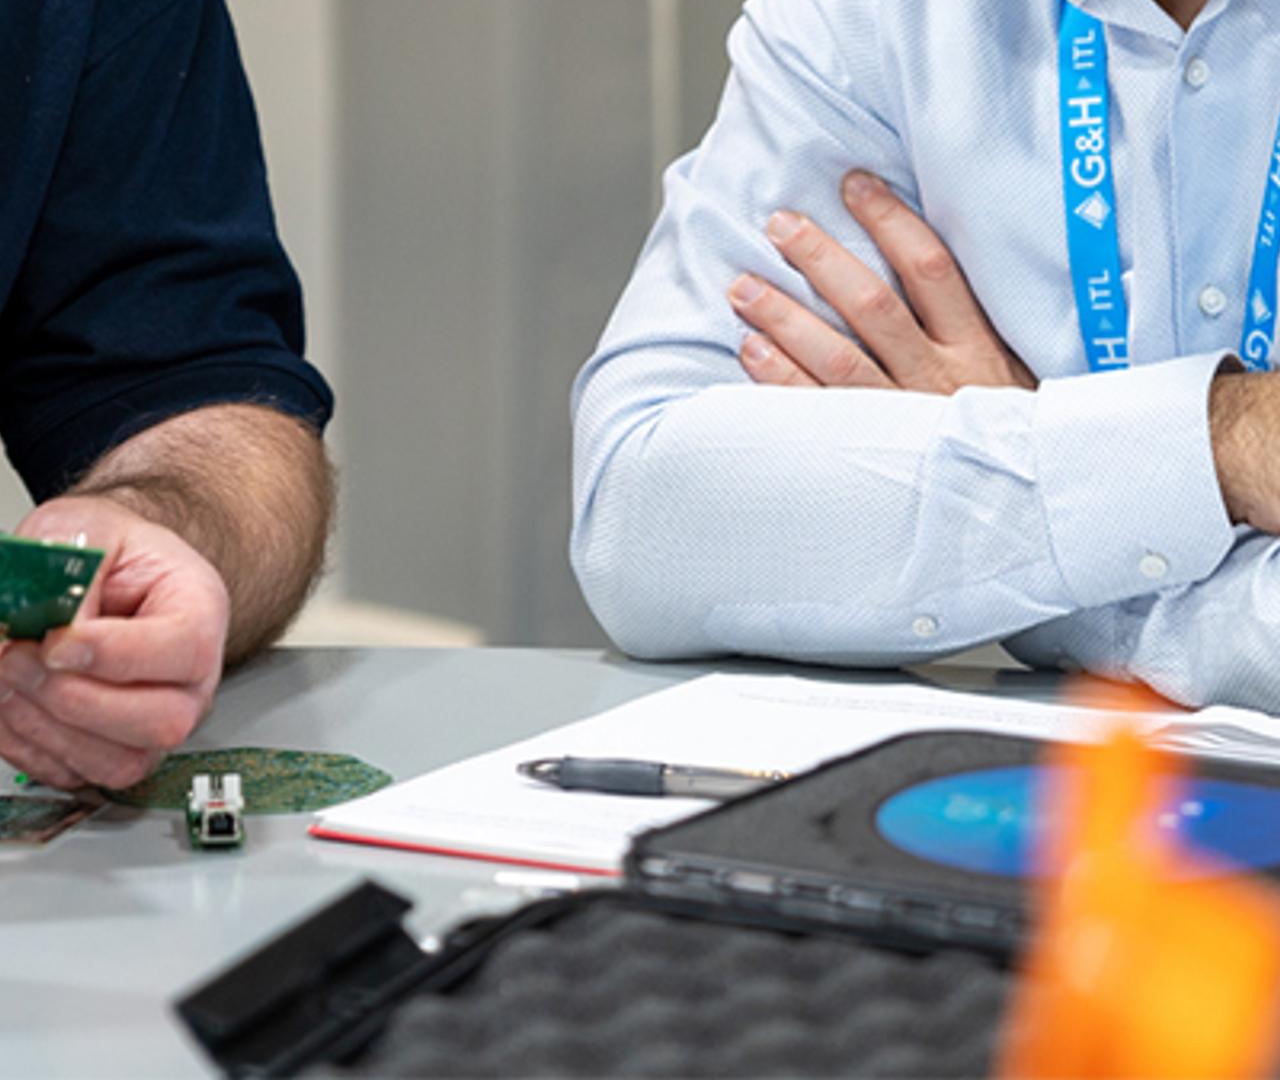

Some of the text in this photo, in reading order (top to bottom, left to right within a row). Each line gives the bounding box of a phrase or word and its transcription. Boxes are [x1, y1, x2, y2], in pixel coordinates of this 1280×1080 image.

[1068, 28, 1106, 189] G&H ITL
[1087, 269, 1114, 310] ITL
